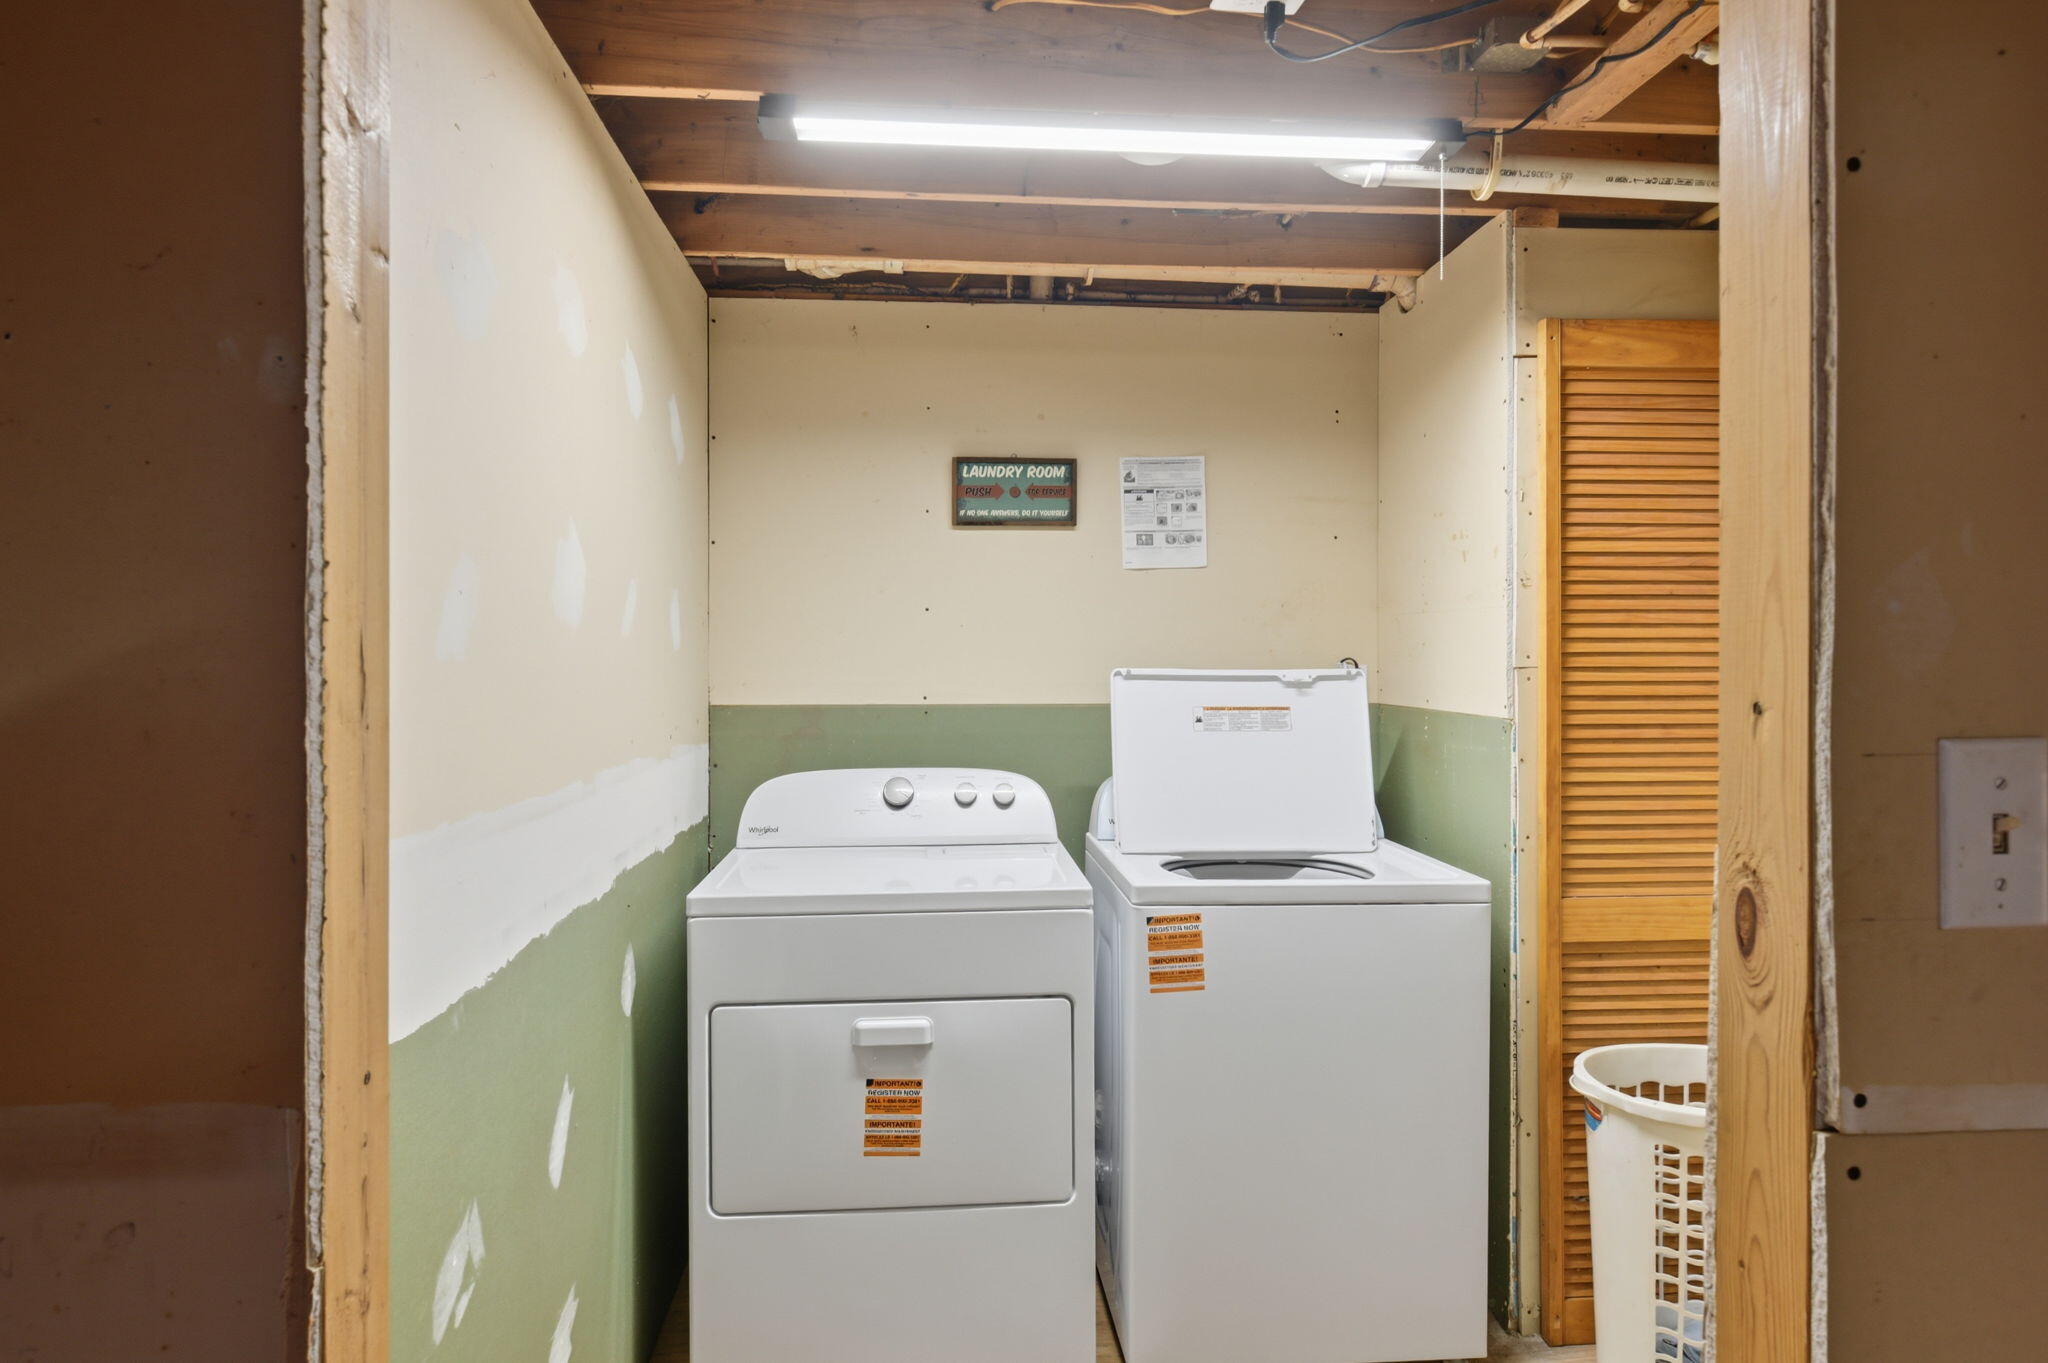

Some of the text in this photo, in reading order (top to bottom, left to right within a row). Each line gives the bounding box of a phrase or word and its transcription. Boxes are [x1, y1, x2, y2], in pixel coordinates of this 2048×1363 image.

[962, 465, 1066, 478] LAUNDRY ROOM
[965, 487, 992, 496] PUSH
[748, 825, 779, 836] Whirlpool
[1149, 925, 1183, 933] REGISTER
